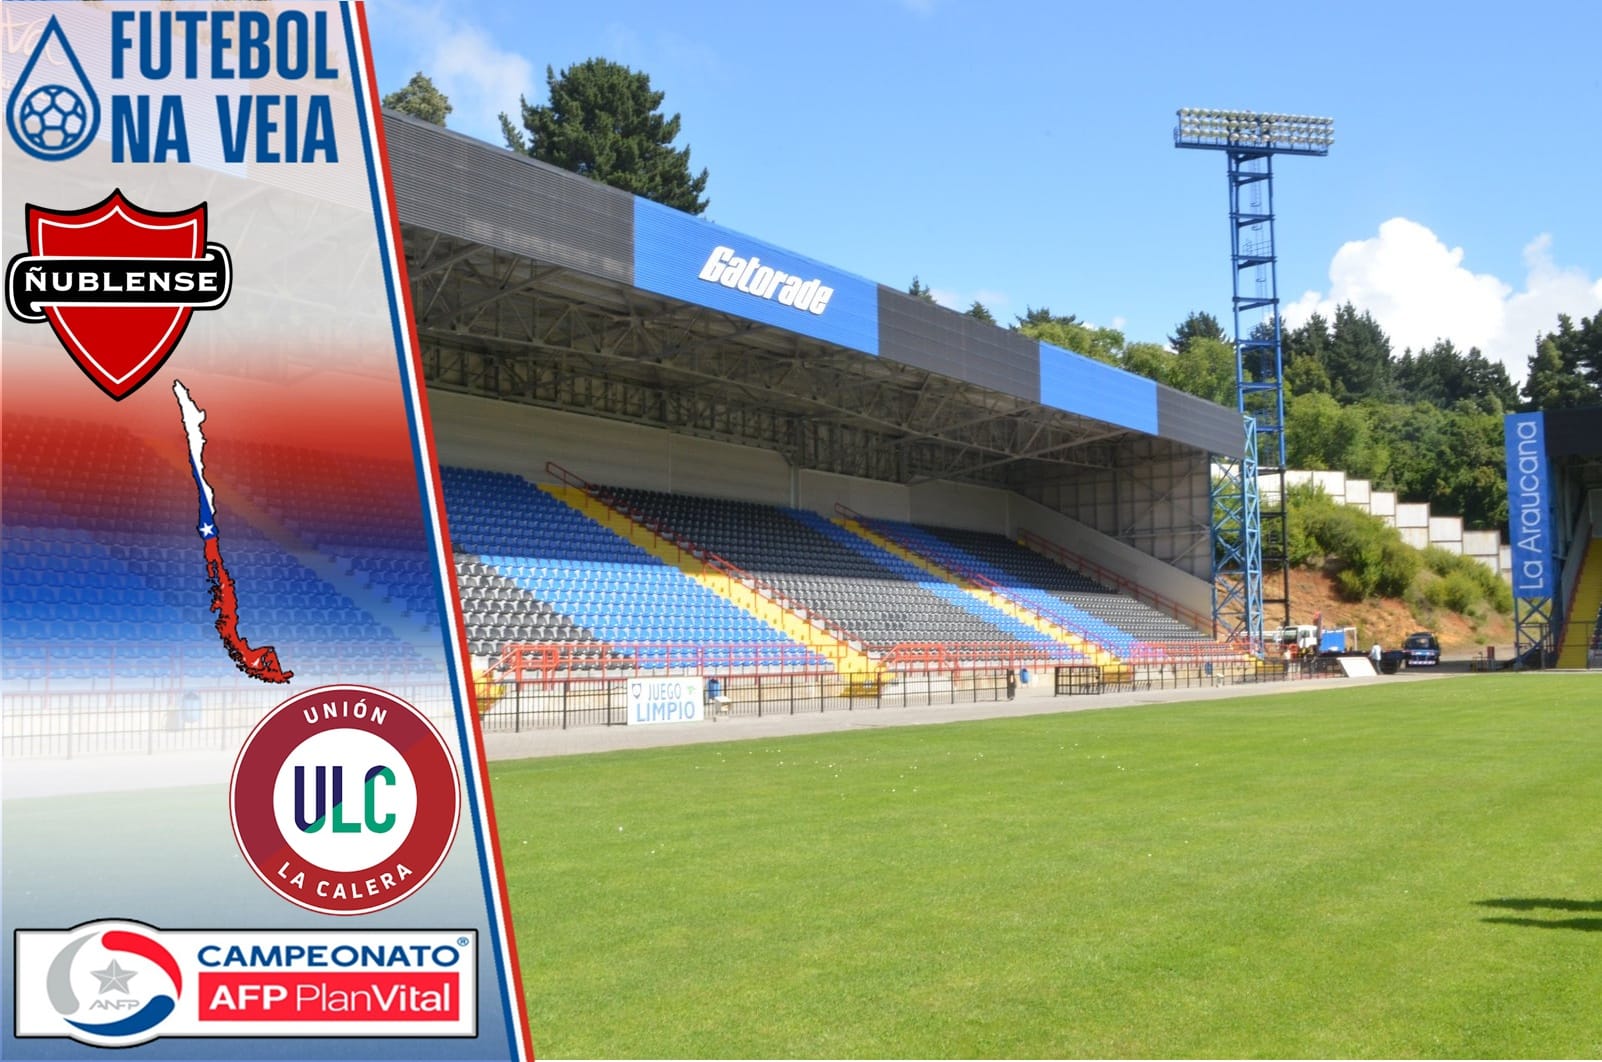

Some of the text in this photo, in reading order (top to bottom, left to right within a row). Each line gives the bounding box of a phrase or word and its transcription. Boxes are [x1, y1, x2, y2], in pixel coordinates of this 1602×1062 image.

[698, 245, 834, 315] Gatorade
[1517, 420, 1544, 590] La Araucana
[636, 701, 695, 723] LIMPIO
[647, 683, 682, 701] JUEGO
